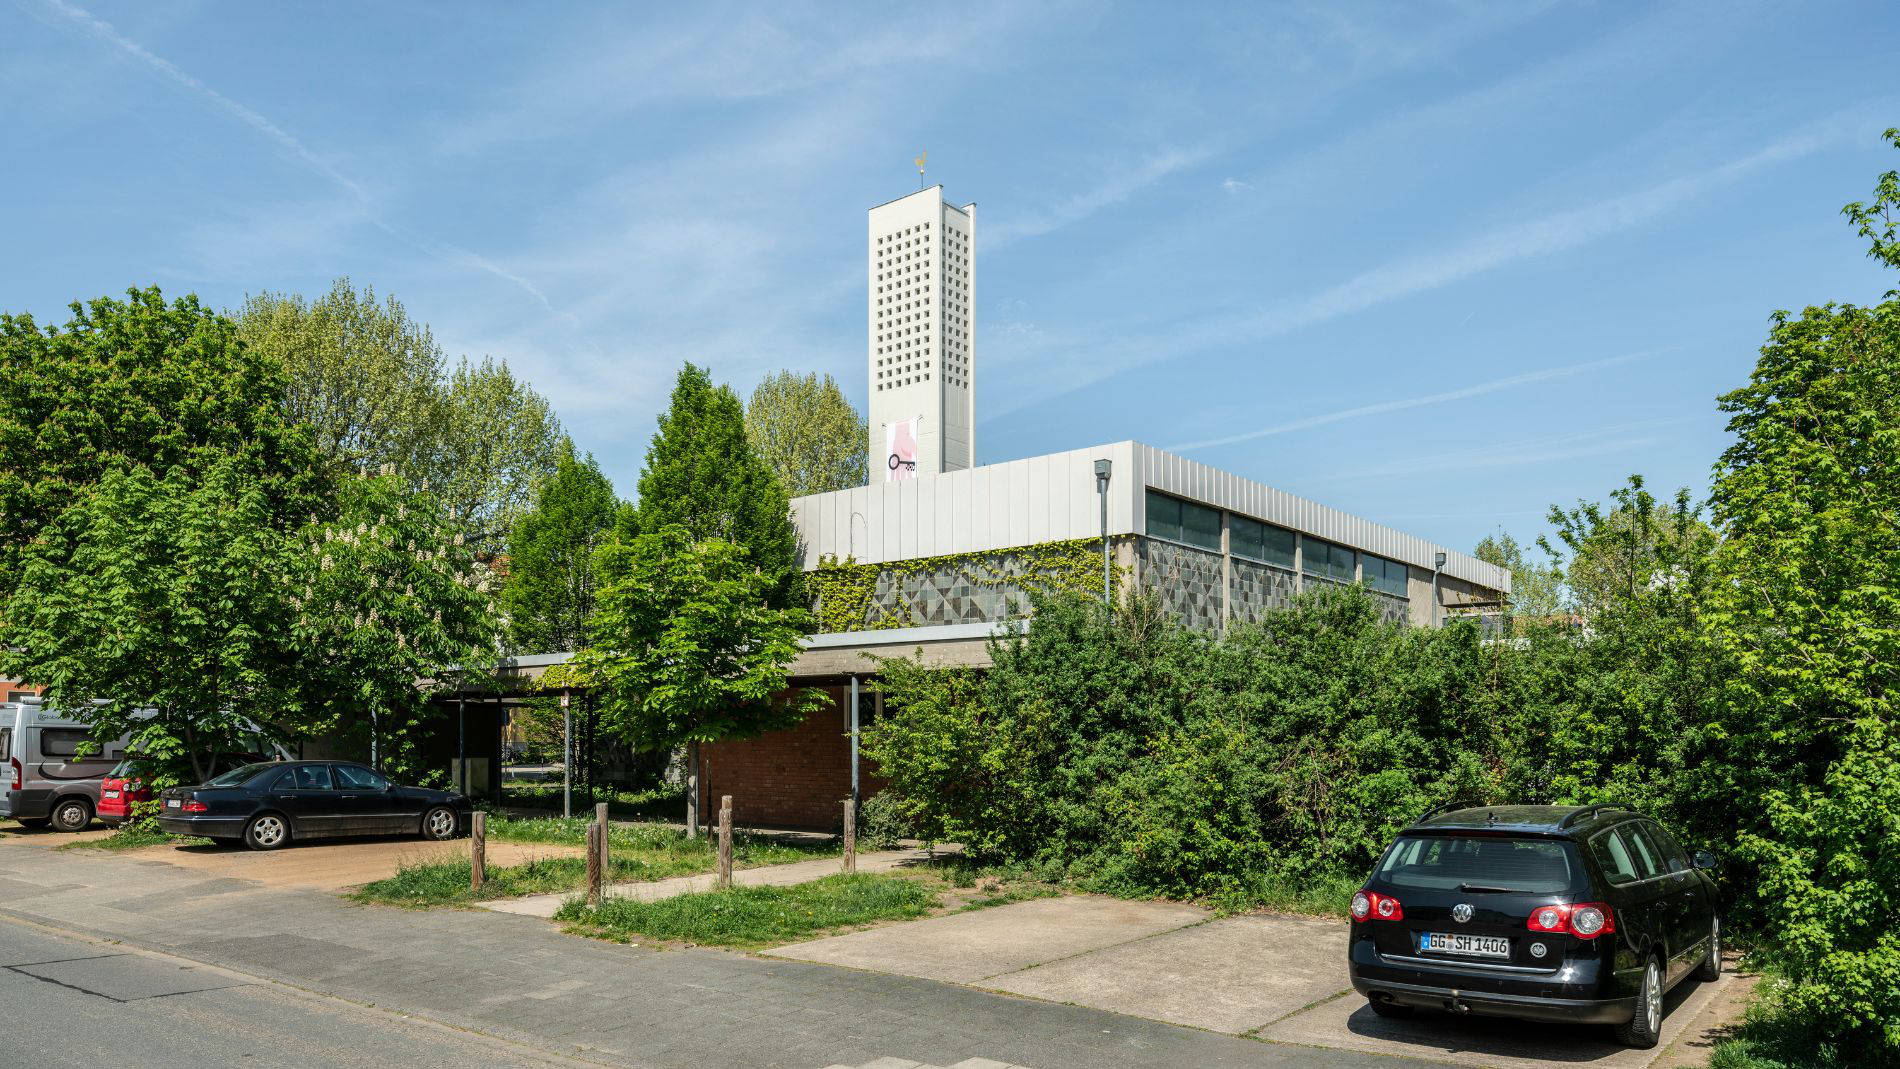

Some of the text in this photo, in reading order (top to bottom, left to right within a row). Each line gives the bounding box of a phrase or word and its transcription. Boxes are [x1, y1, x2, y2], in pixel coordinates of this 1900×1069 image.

[1430, 934, 1507, 953] GG SH 1406
